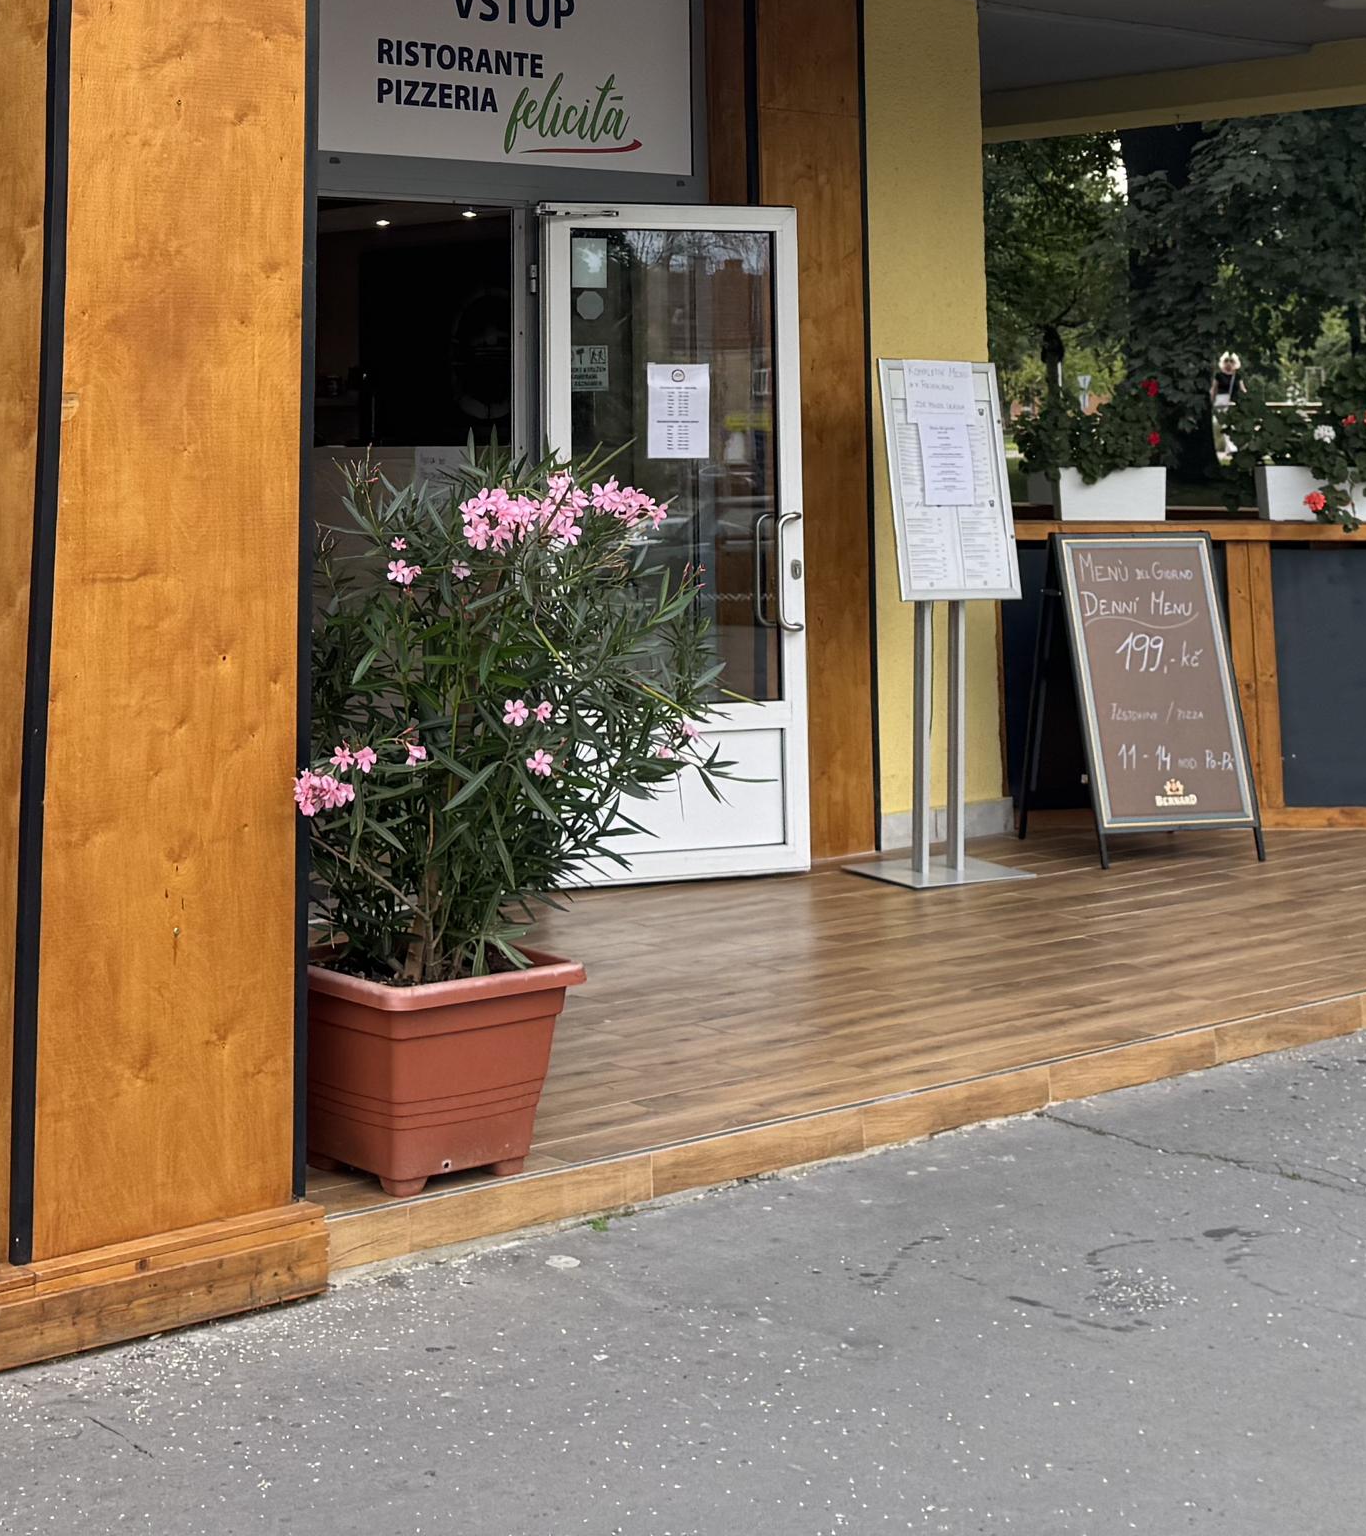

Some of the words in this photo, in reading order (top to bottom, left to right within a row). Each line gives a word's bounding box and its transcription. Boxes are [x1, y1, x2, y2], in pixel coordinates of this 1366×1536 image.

[377, 38, 544, 79] RISTORANTE
[377, 77, 498, 113] PIZZERIA
[1151, 590, 1192, 616] MENU
[1117, 743, 1136, 770] 11
[1155, 744, 1171, 771] 14
[1154, 794, 1198, 807] BERNARD
